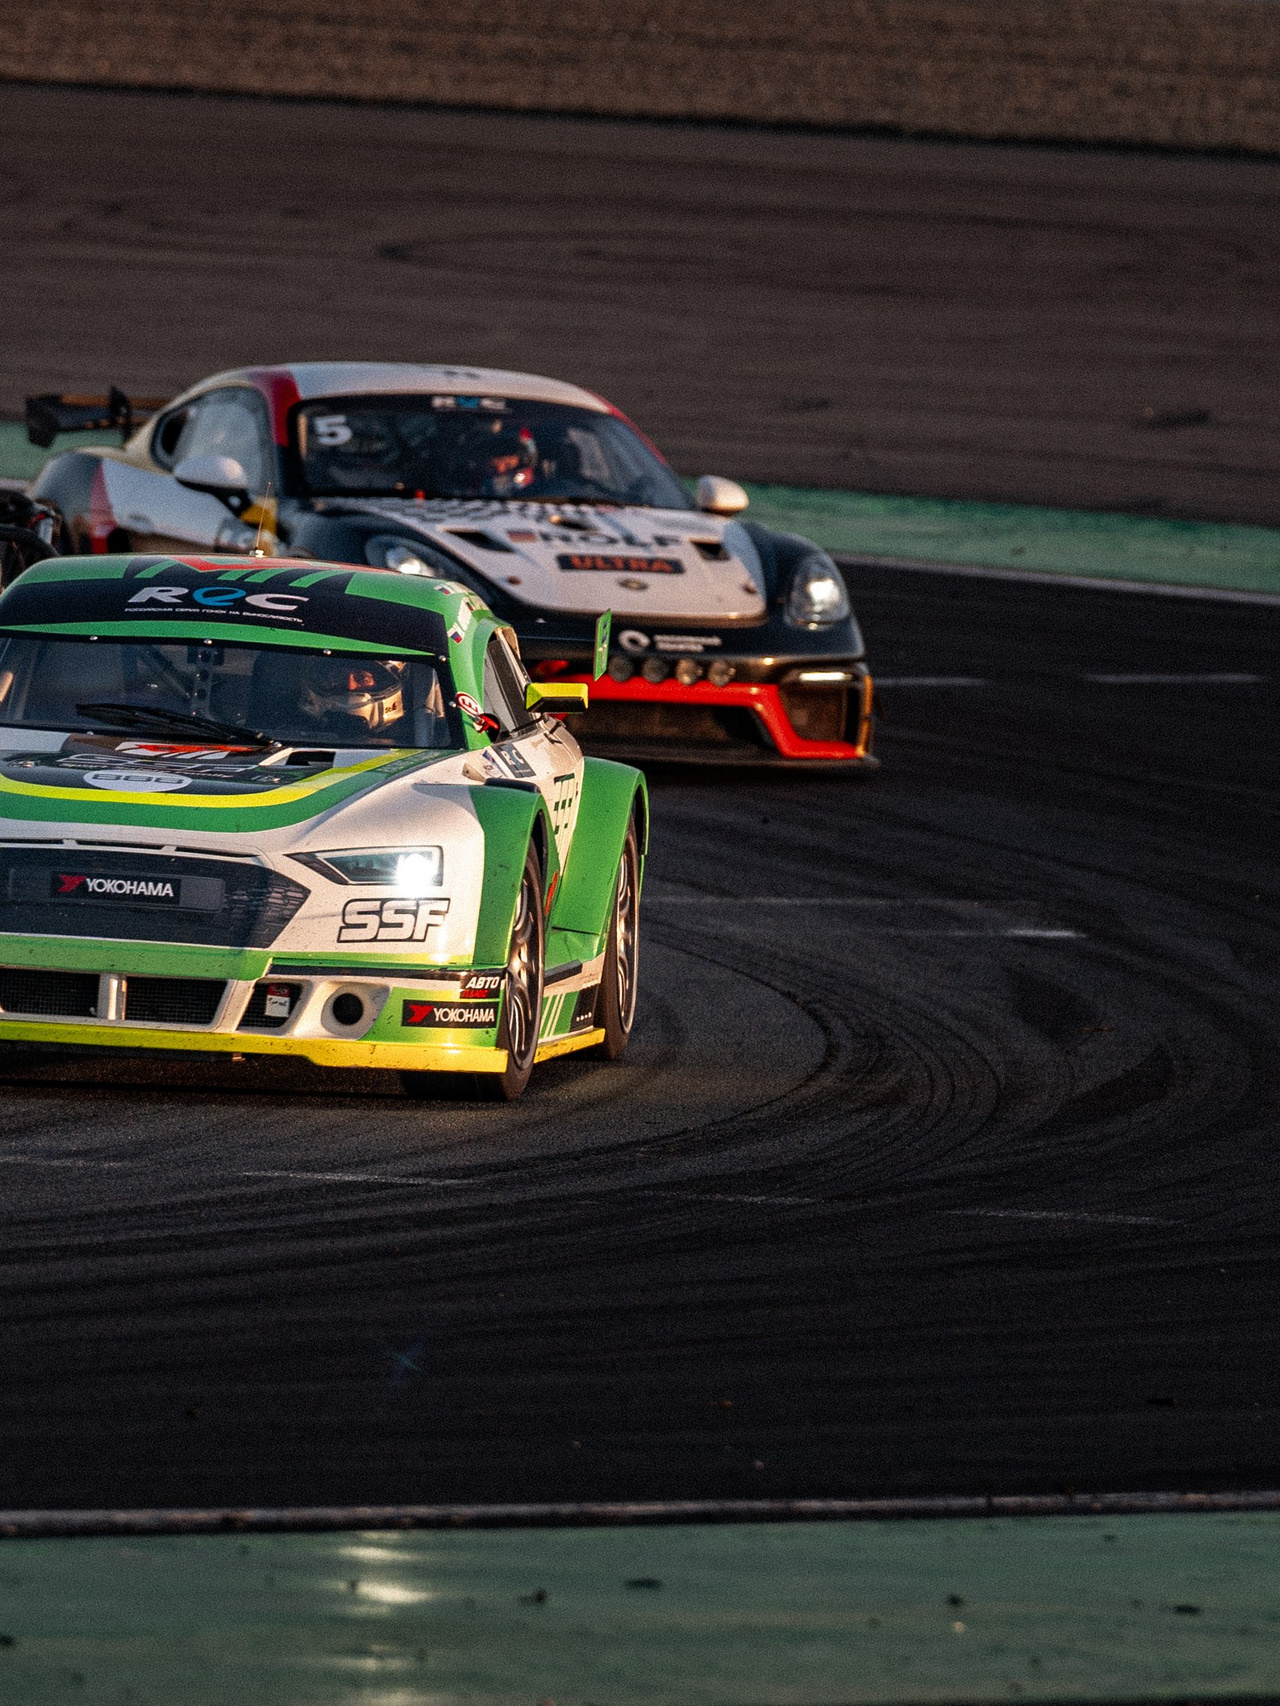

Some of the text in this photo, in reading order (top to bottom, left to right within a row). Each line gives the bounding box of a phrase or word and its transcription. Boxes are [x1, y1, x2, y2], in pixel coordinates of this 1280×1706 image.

[314, 414, 353, 446] 5
[570, 555, 674, 573] ULTRA
[86, 878, 174, 897] YOKOHAMA
[336, 897, 451, 943] SSF
[433, 1007, 495, 1022] YOKOHAMA
